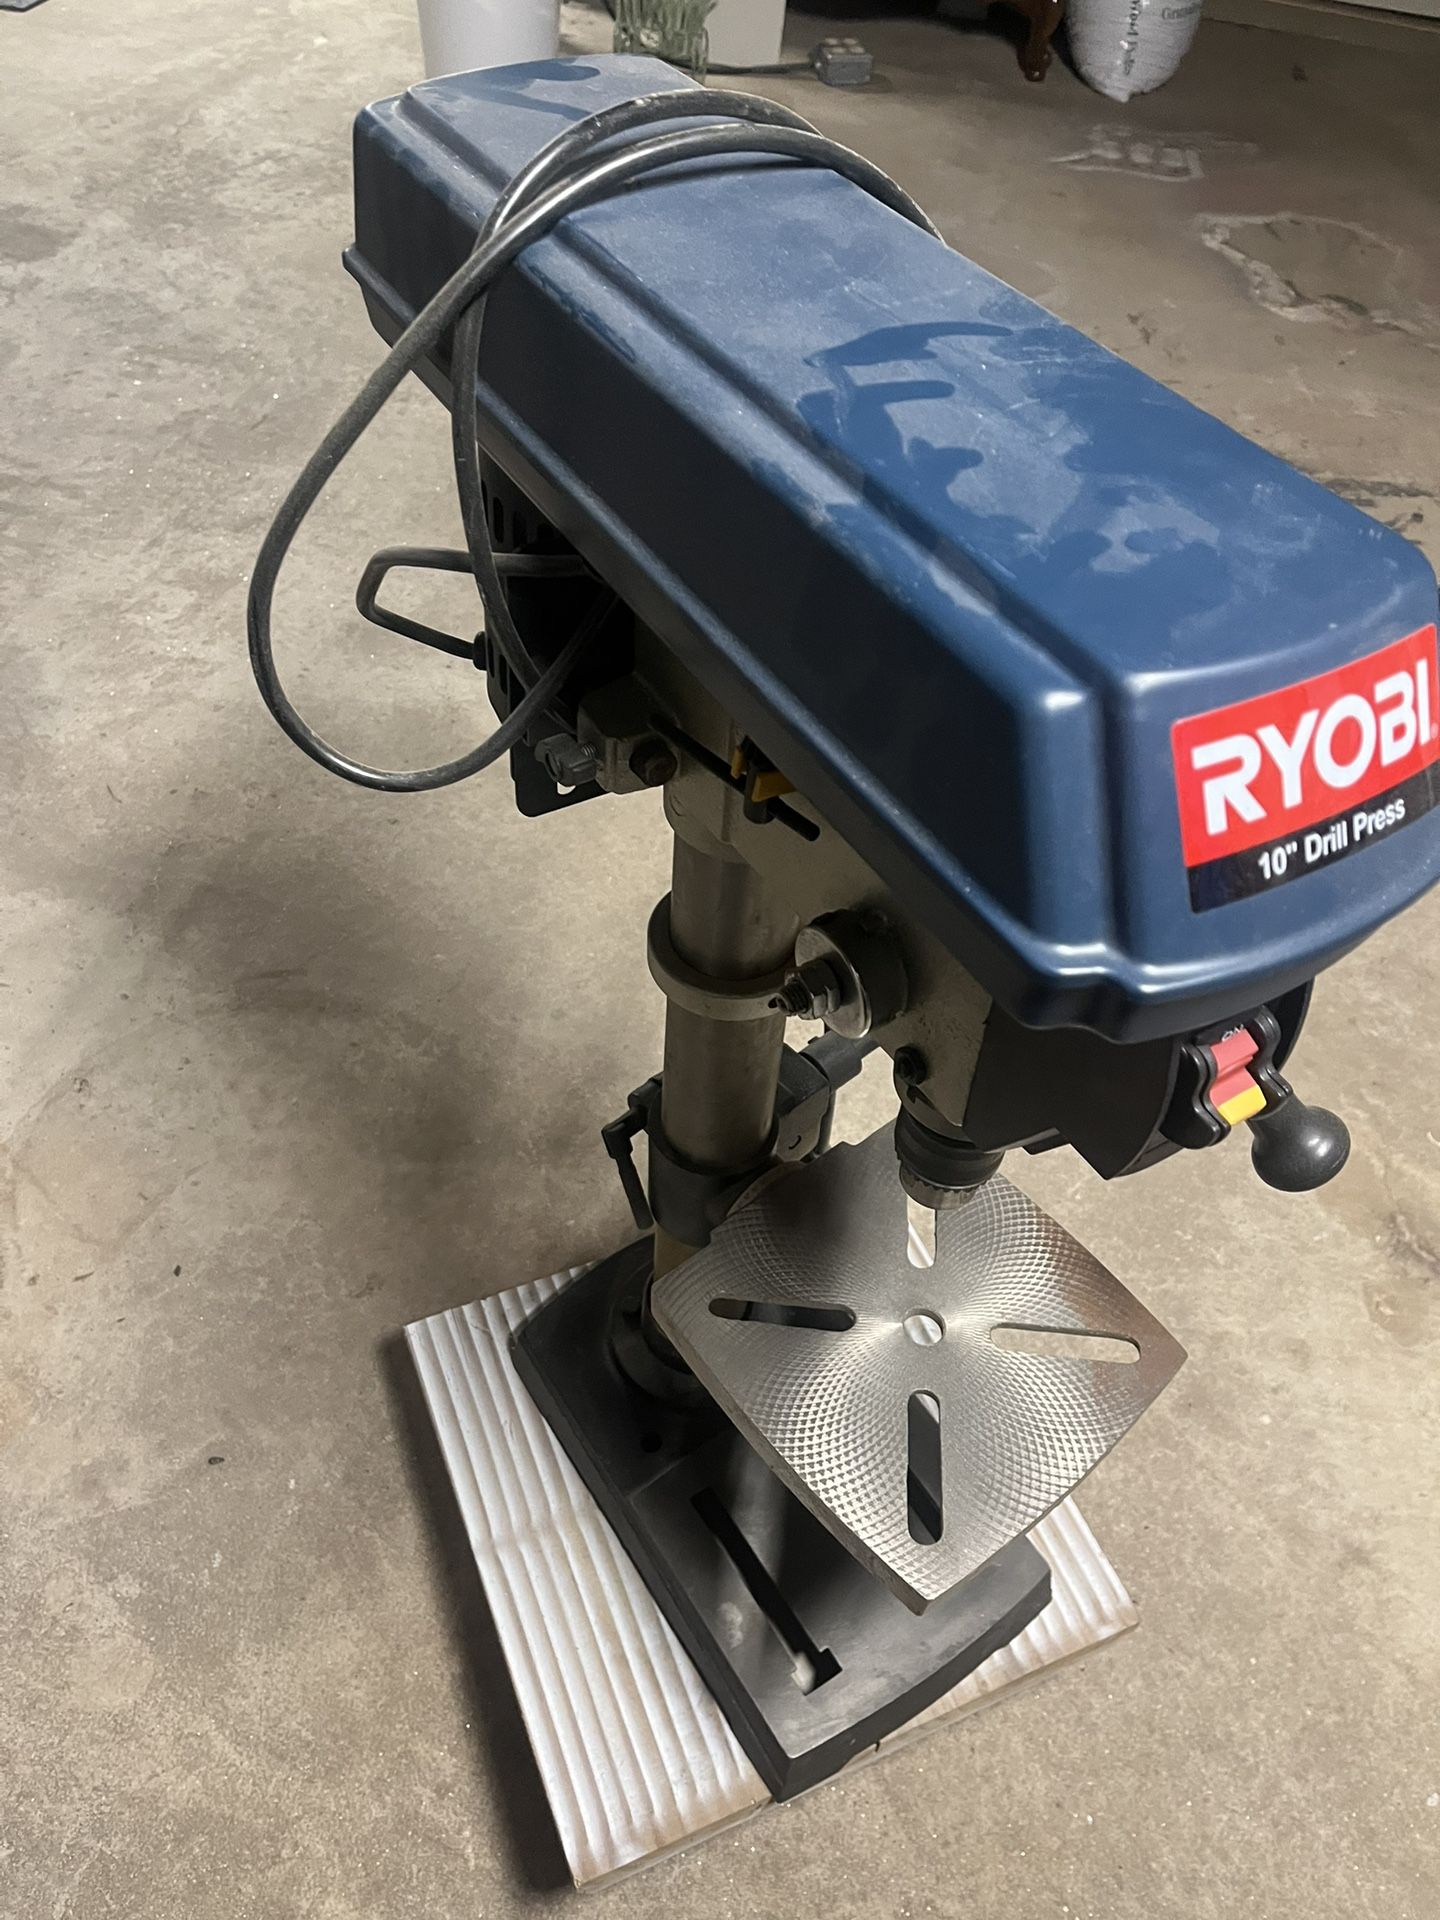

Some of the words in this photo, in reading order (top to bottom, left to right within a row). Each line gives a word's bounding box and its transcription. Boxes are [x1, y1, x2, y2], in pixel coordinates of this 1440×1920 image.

[1192, 659, 1430, 836] RYOBI
[1258, 842, 1297, 880] 10"
[1304, 821, 1348, 864] Drill
[1353, 798, 1406, 842] Press
